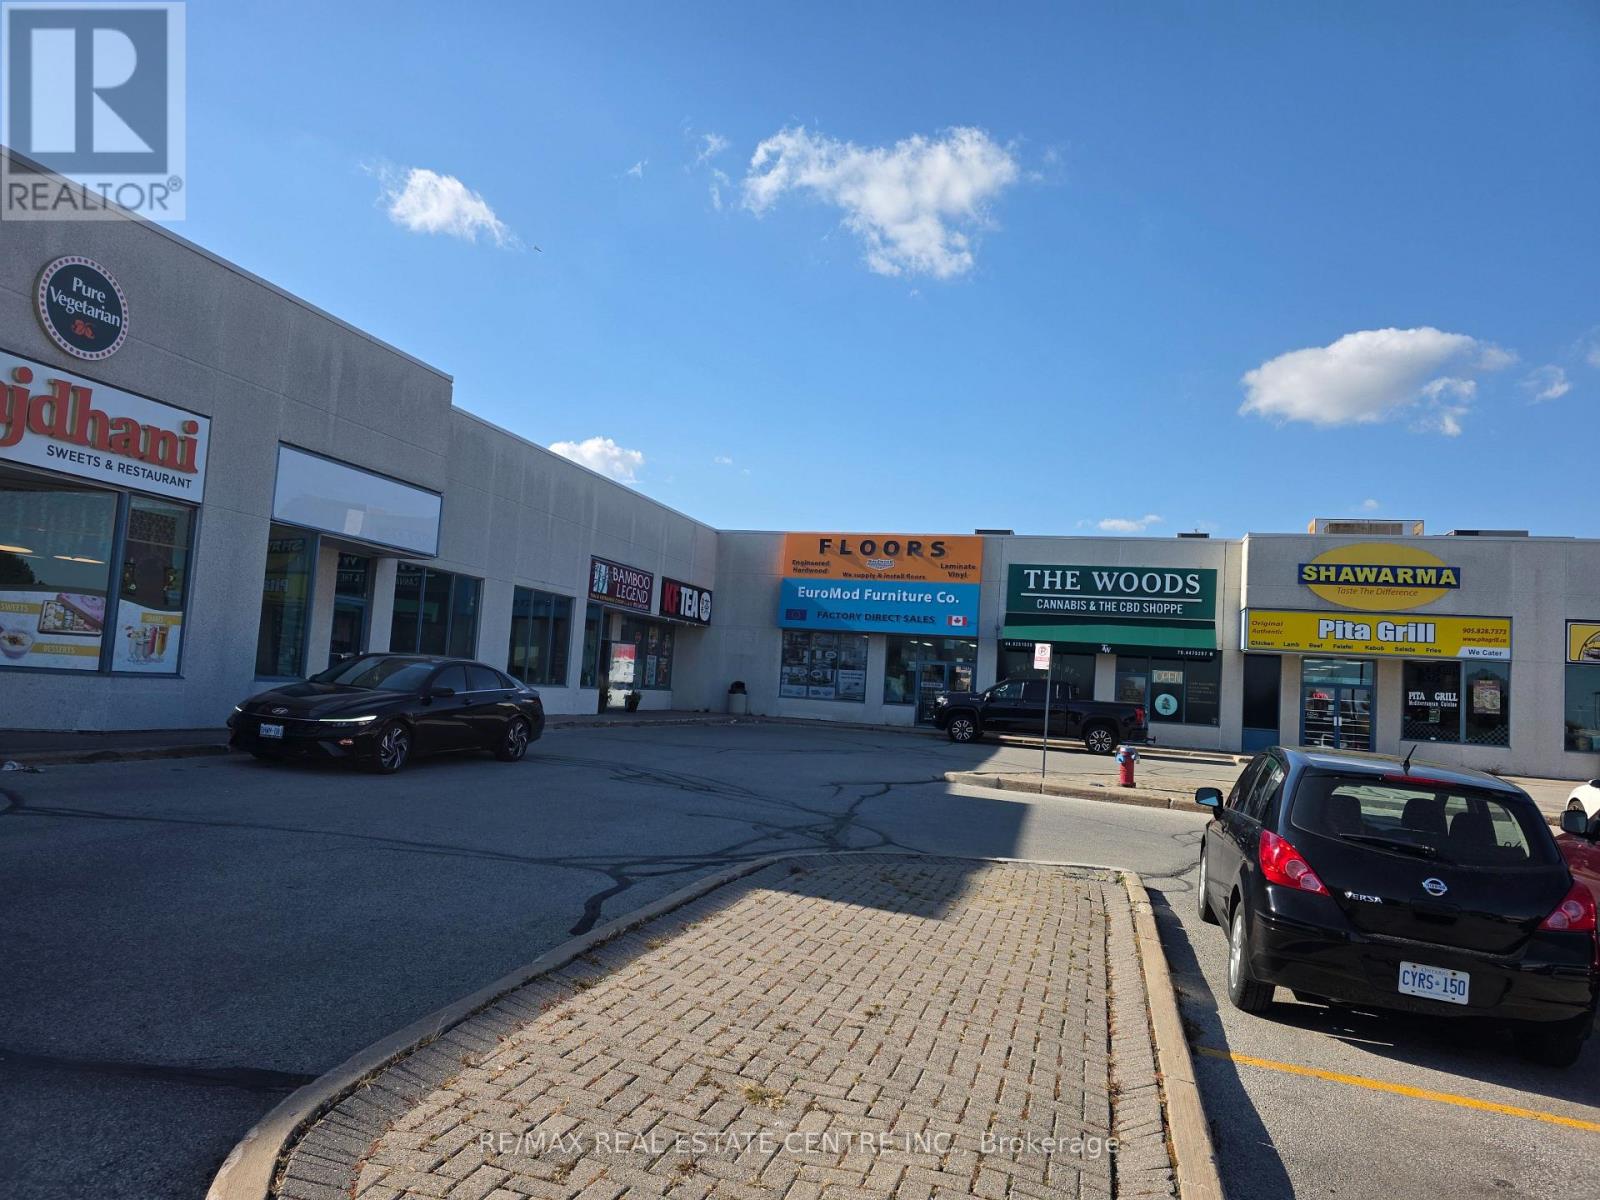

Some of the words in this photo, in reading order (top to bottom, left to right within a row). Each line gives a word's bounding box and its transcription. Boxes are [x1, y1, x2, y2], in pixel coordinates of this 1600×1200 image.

[72, 276, 106, 303] Pure
[50, 285, 121, 327] Vegetarian
[46, 444, 101, 468] SWEETS
[105, 460, 113, 471] &
[117, 463, 192, 489] RESTAURANT
[819, 539, 946, 557] FLOORS
[940, 562, 976, 570] Laminate
[612, 567, 651, 590] BAMBOO
[854, 572, 875, 580] supply
[948, 571, 967, 579] Vinyl
[1024, 569, 1081, 590] THE
[1092, 571, 1200, 594] WOODS
[1301, 565, 1457, 586] SHAWARMA
[616, 583, 649, 604] LEGEND
[798, 586, 859, 600] EuroMod
[864, 588, 932, 603] Furniture
[936, 591, 959, 603] Co.
[1336, 586, 1358, 596] Taste
[1360, 587, 1374, 596] The
[1376, 587, 1418, 598] Difference
[680, 587, 698, 618] TEA
[1036, 599, 1087, 611] CANNABIS
[1089, 601, 1096, 611] &
[1099, 601, 1117, 612] THE
[1119, 602, 1140, 613] CBD
[1143, 603, 1183, 615] SHOPPE
[817, 611, 861, 621] FACTORY
[864, 612, 900, 623] DIRECT
[903, 614, 936, 624] SALES
[1252, 620, 1284, 628] Original
[1318, 619, 1371, 641] Pita
[1377, 621, 1437, 644] Grill
[1482, 649, 1502, 657] Cater
[1408, 691, 1425, 700] PITA
[1434, 692, 1459, 702] GRILL
[1343, 890, 1383, 904] VERSA
[1402, 970, 1433, 990] CYRS
[1443, 977, 1465, 996] 150
